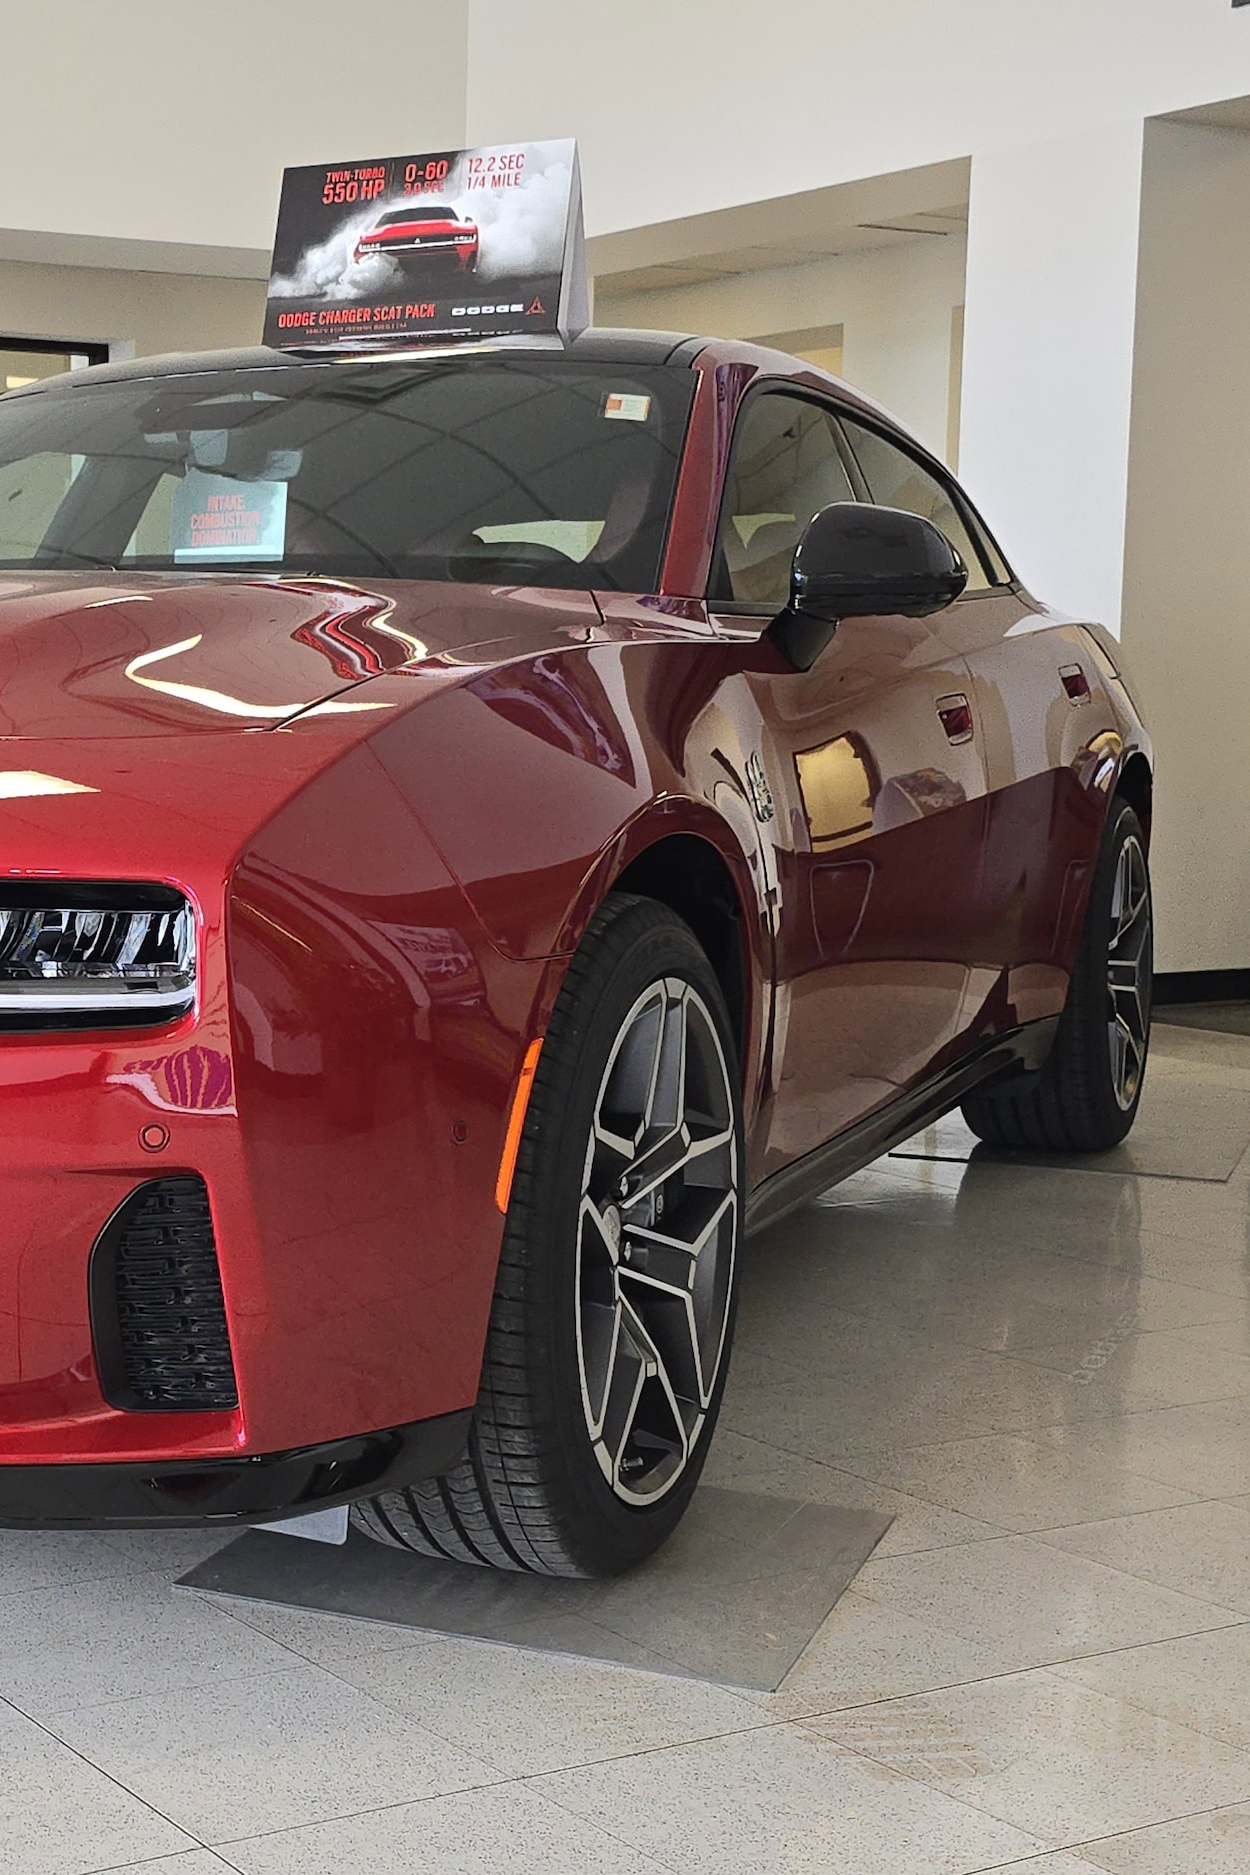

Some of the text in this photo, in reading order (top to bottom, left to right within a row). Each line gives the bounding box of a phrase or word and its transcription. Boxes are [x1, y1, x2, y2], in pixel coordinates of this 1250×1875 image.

[405, 160, 448, 183] 0-60
[468, 154, 525, 174] 12.2 SEC
[326, 166, 385, 183] TWIN-TURBO
[467, 172, 521, 190] 1/4 MILE
[322, 178, 385, 205] 550 HP
[278, 303, 436, 328] DODGE CHARGER SCAT PACK
[451, 303, 524, 316] DODGE
[207, 494, 247, 511] INTAKE
[190, 511, 261, 529] COMBUSTION
